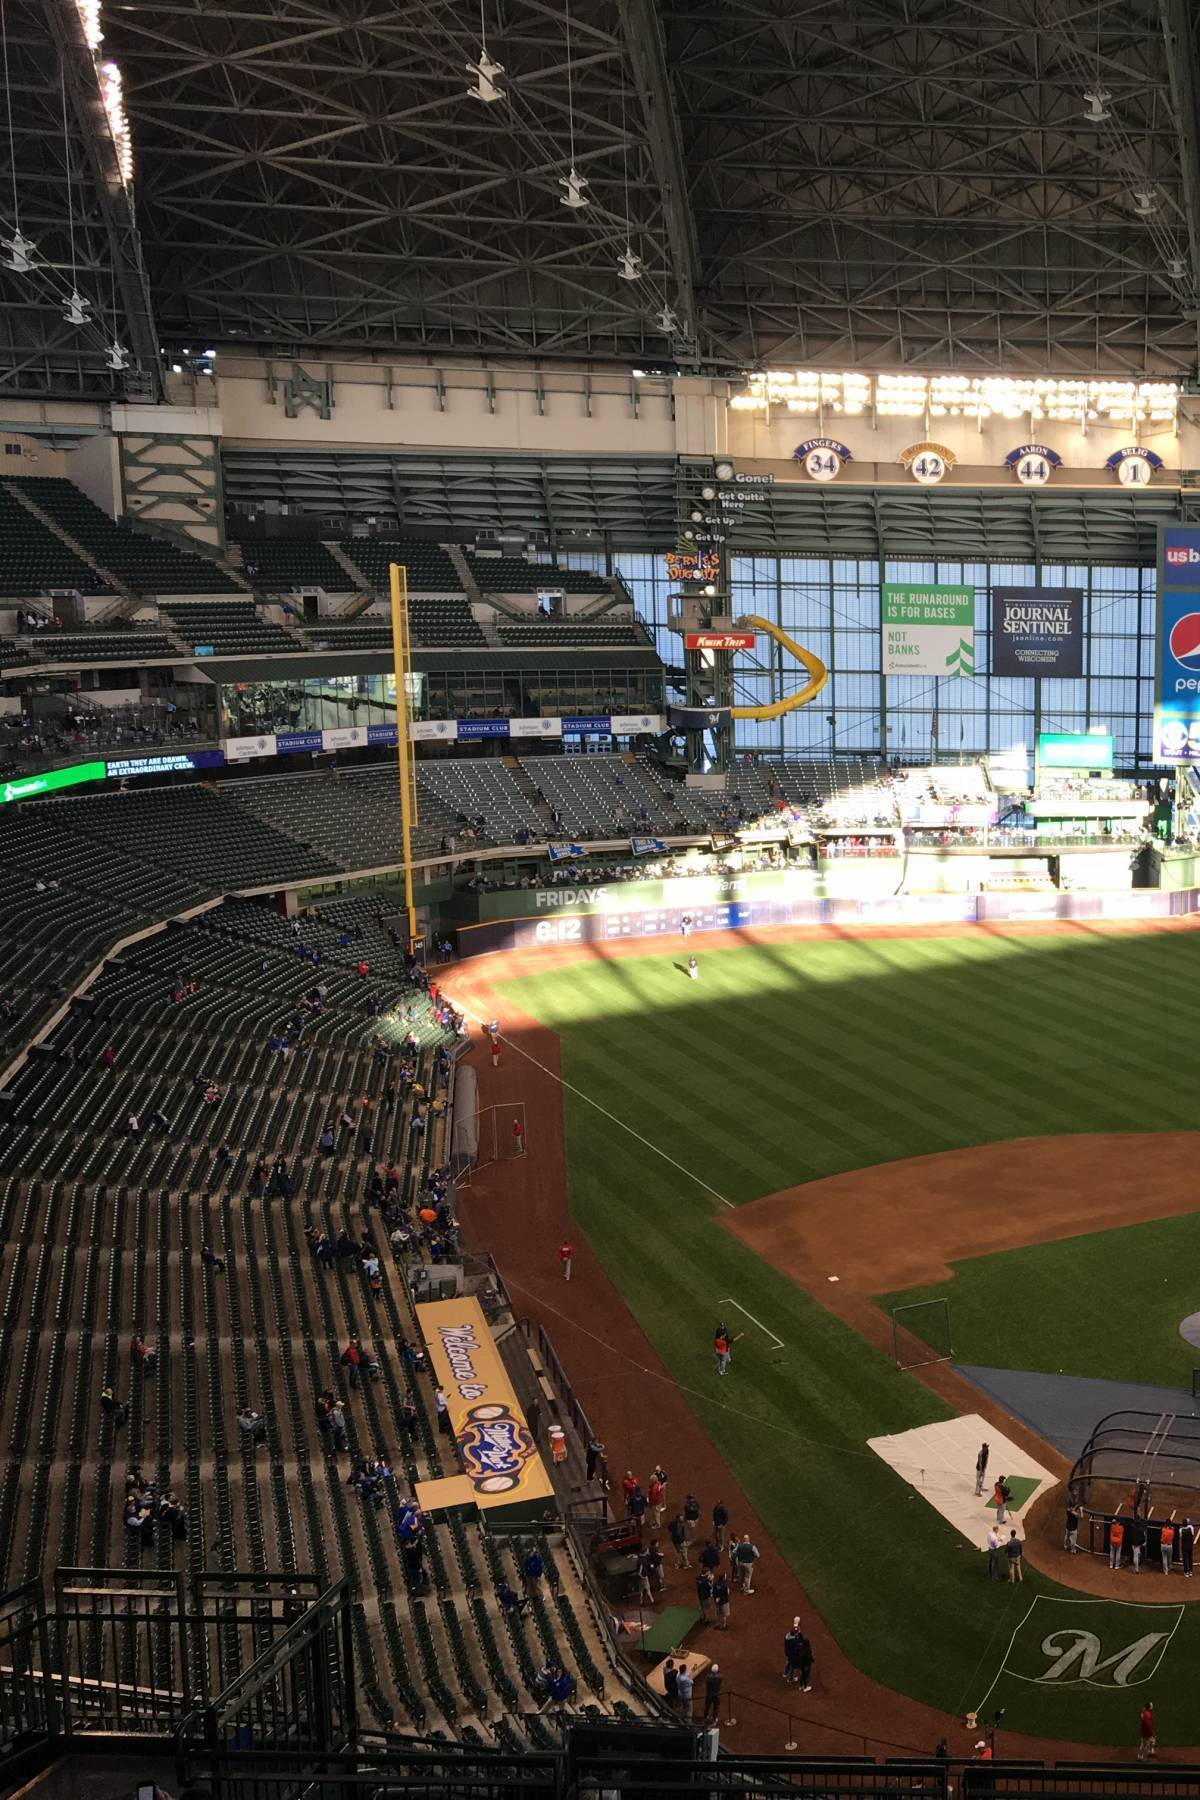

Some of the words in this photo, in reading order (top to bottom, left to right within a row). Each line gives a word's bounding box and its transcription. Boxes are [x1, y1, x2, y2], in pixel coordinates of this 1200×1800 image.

[803, 439, 842, 452] FINGERS
[1019, 446, 1049, 456] AARON
[1121, 448, 1148, 456] SELIG
[810, 454, 836, 474] 34
[915, 457, 943, 475] 42
[1020, 461, 1047, 479] 44
[735, 473, 774, 484] Gone!
[1129, 463, 1140, 482] 1
[718, 492, 735, 500] Get
[737, 492, 765, 501] Outta
[705, 516, 721, 524] Get
[722, 517, 735, 526] Up
[695, 533, 712, 541] Get
[713, 534, 725, 543] Up
[887, 592, 905, 604] THE
[909, 593, 969, 606] RUNAROUND
[888, 606, 898, 617] IS
[901, 606, 921, 618] FOR
[924, 607, 956, 619] BASES
[1004, 607, 1072, 621] JOURNAL
[1003, 621, 1072, 635] SENTINEL
[696, 636, 722, 647] KWIK
[724, 636, 746, 647] TRIP
[888, 631, 908, 643] NOT
[1012, 634, 1064, 643] jsonline.com
[888, 644, 920, 656] BANKS
[1014, 649, 1060, 657] CONNECTING
[458, 726, 488, 734] STADIUM
[563, 722, 592, 730] STADIUM
[368, 731, 393, 740] STADIUM
[277, 738, 305, 748] STADIUM
[306, 737, 322, 745] CLUB
[107, 760, 129, 769] EARTH
[130, 759, 148, 768] THEY
[148, 758, 162, 767] ARE
[107, 768, 117, 777] AN
[118, 764, 173, 776] EXTRAORDINARY
[174, 762, 195, 771] CREW.
[535, 887, 607, 908] FRIDAYS
[535, 919, 582, 942] 6:12
[438, 1324, 481, 1382] Welcome
[458, 1383, 488, 1400] to
[1034, 1629, 1170, 1687] M
